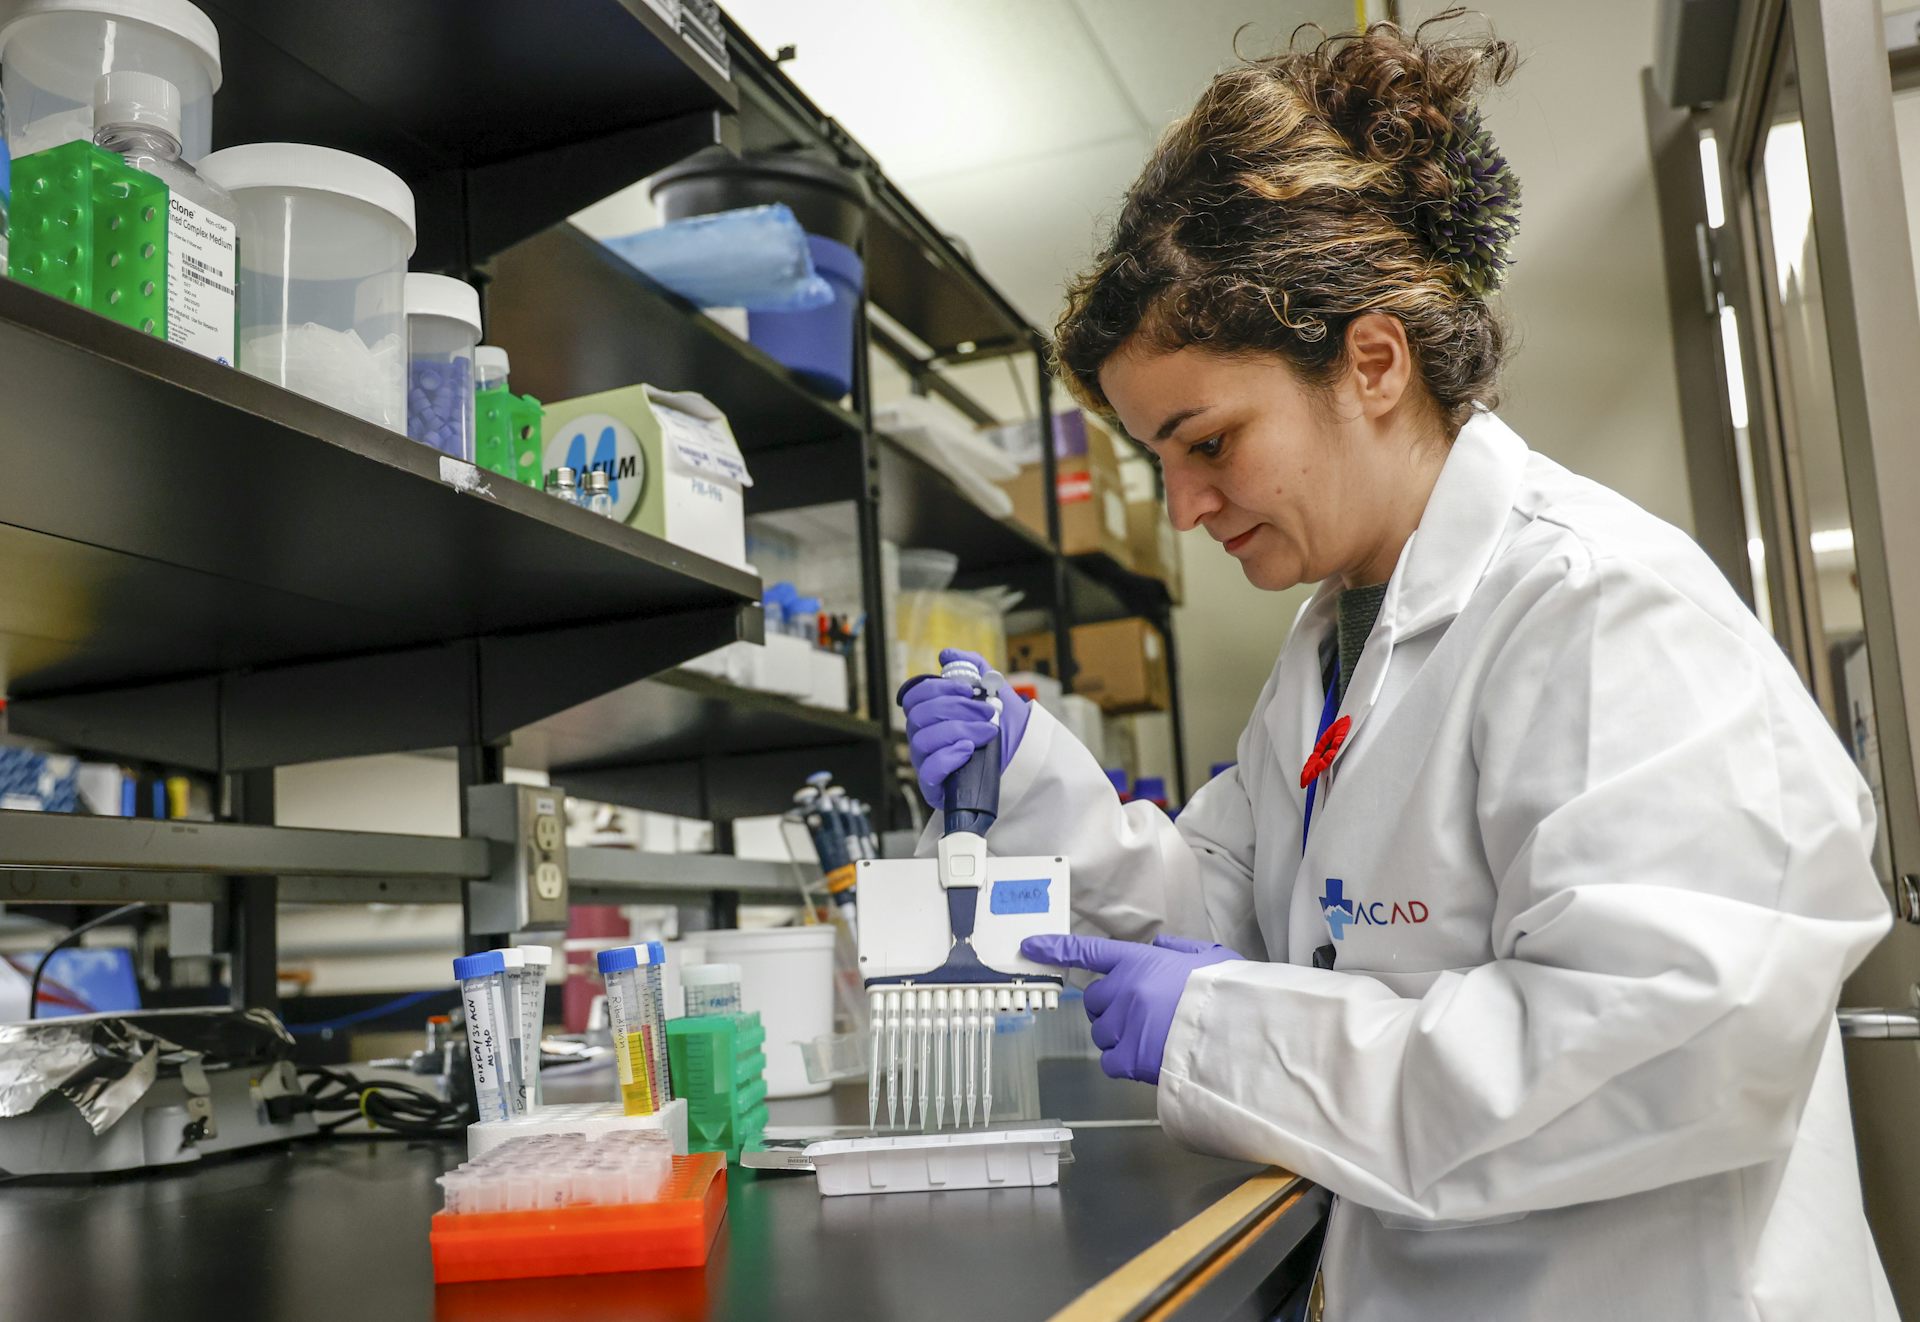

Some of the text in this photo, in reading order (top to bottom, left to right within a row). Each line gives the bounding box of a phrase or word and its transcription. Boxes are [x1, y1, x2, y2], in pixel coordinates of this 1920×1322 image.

[169, 199, 194, 219] Clone
[183, 219, 208, 239] Complex
[209, 232, 233, 251] Medium
[1354, 901, 1429, 925] ACAD
[467, 999, 478, 1021] ACN
